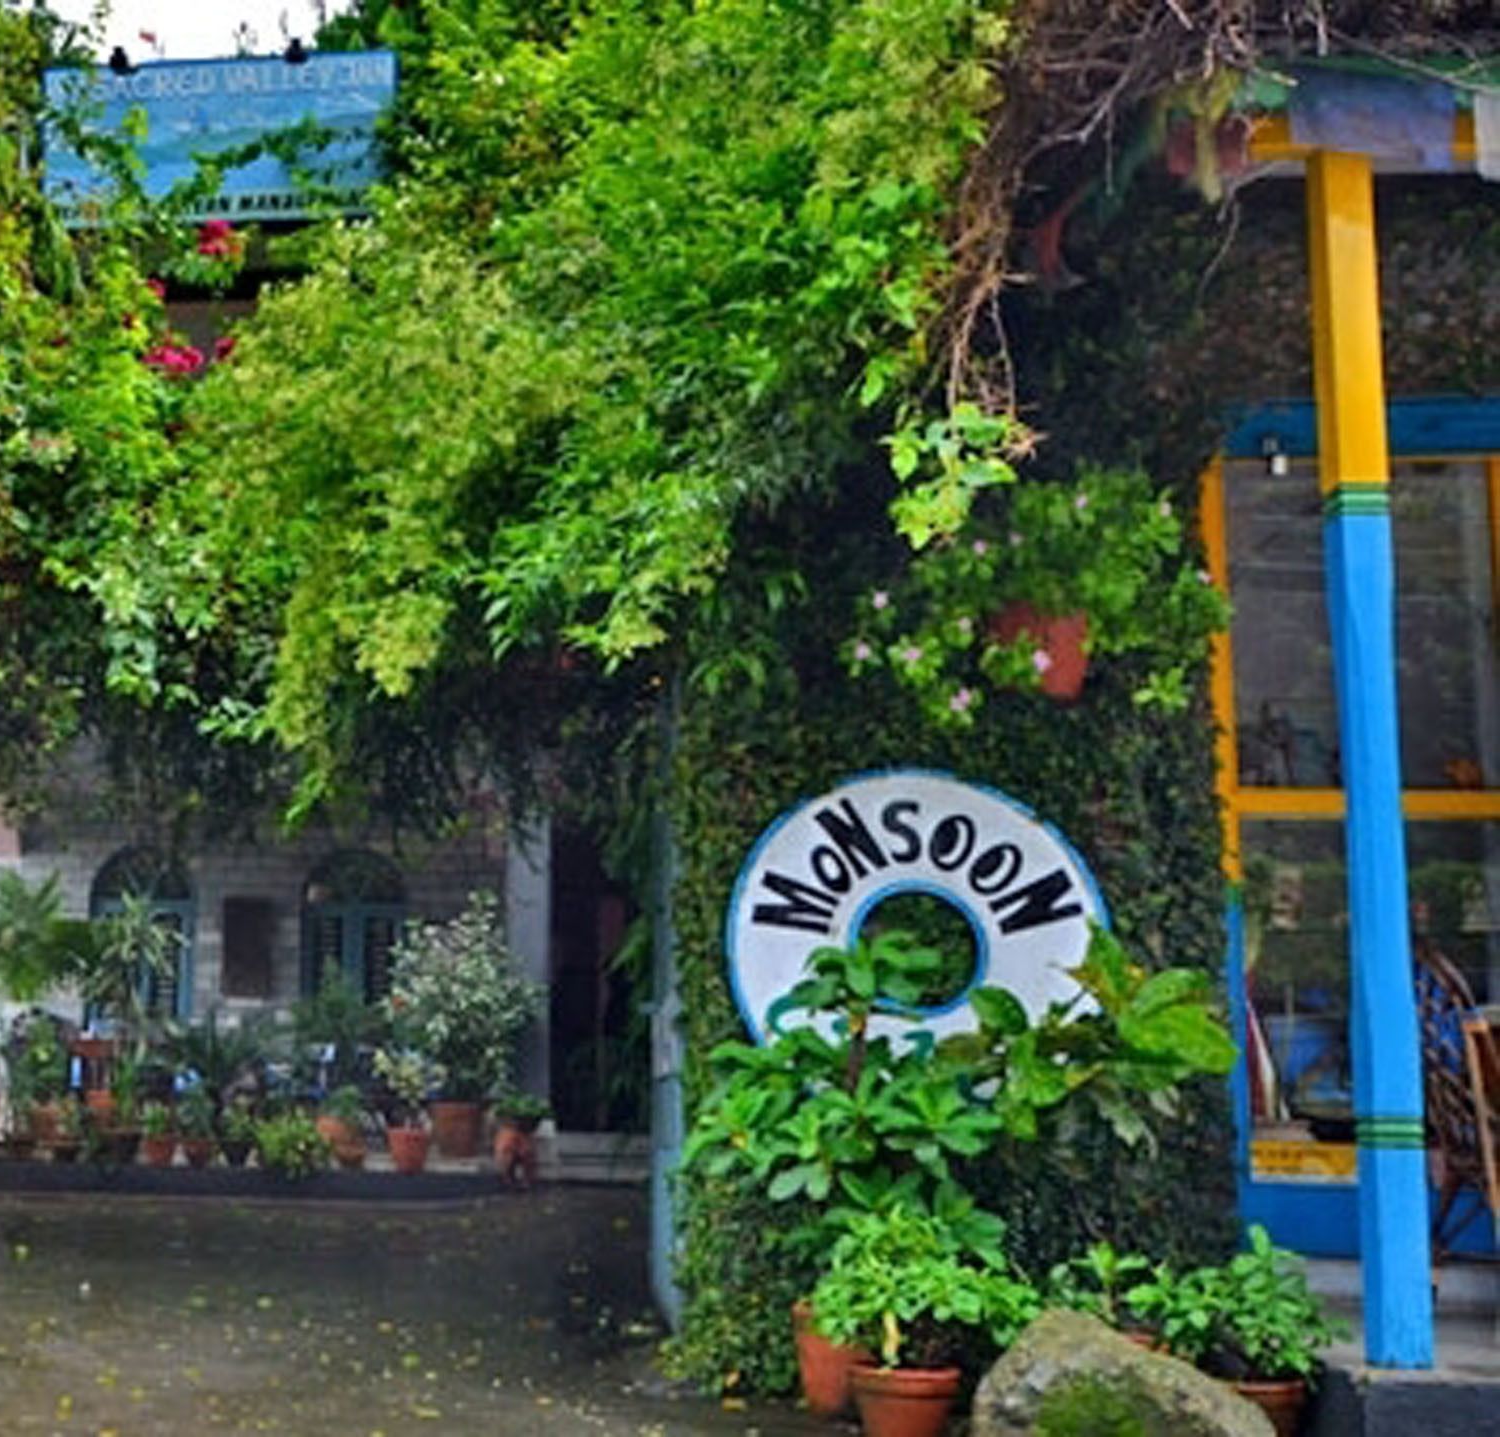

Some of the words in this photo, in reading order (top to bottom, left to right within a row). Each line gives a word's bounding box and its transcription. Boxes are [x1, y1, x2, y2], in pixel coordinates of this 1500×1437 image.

[97, 70, 214, 101] SACRED
[223, 64, 330, 93] VALLEY
[751, 797, 1083, 935] MONSOON
